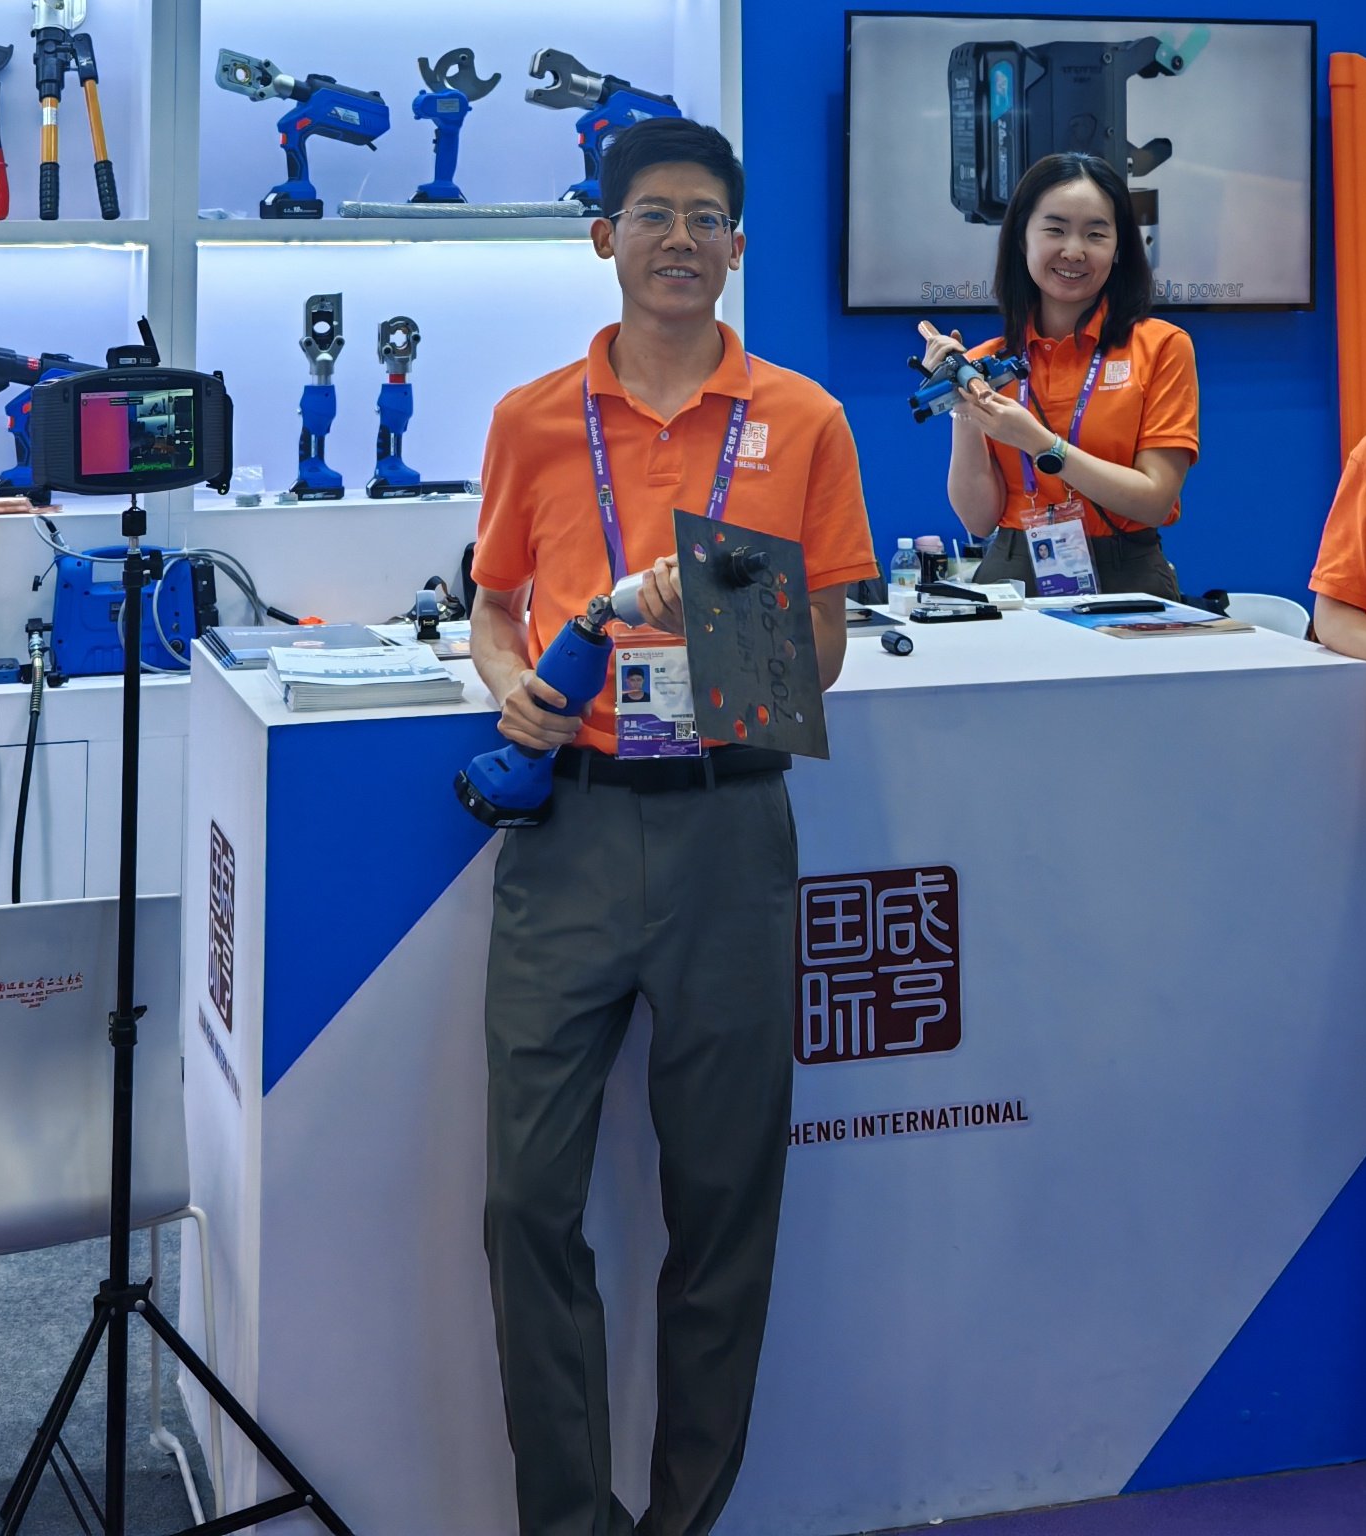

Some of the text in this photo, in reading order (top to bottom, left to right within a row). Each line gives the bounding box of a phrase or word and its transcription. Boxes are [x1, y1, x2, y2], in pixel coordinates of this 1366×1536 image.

[921, 280, 987, 304] Special
[1188, 282, 1244, 302] power
[853, 1099, 1029, 1139] INTERNATIONAL
